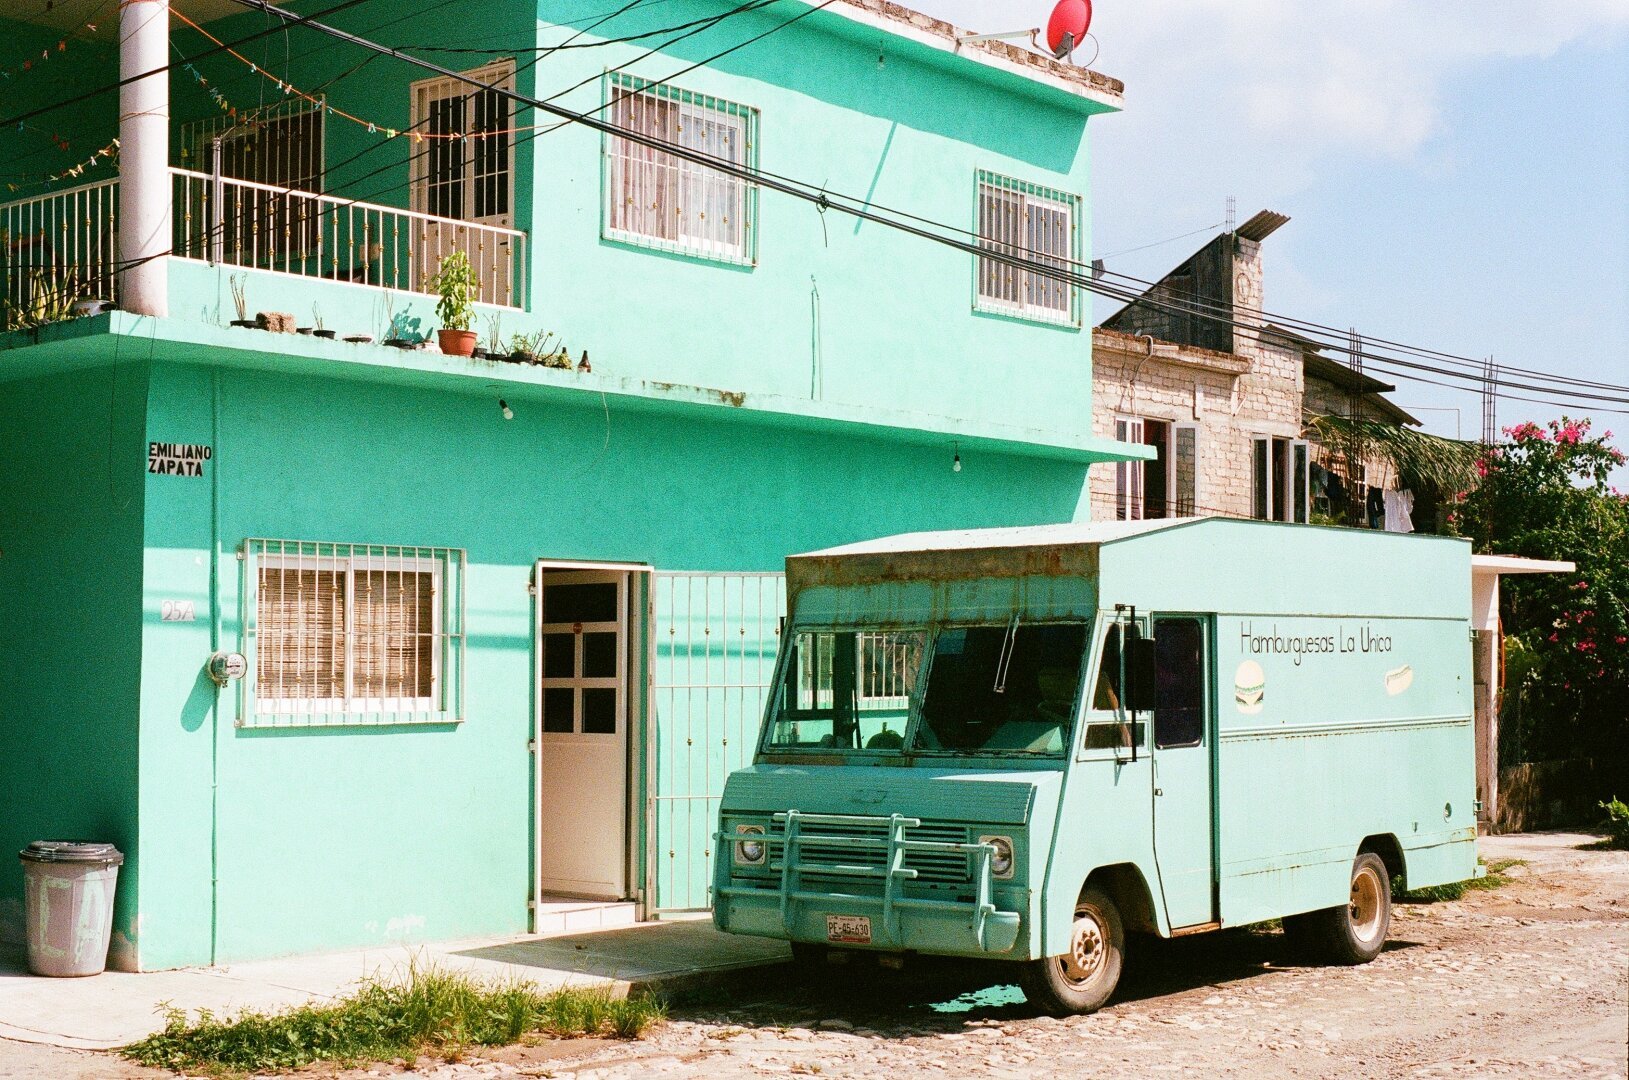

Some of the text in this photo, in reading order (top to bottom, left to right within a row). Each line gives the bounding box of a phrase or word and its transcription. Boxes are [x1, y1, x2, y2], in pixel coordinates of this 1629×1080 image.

[148, 441, 212, 460] EMILIANO
[148, 458, 203, 477] ZAPATA
[163, 600, 196, 621] 25A
[1240, 620, 1392, 666] Hamburguesas La Única
